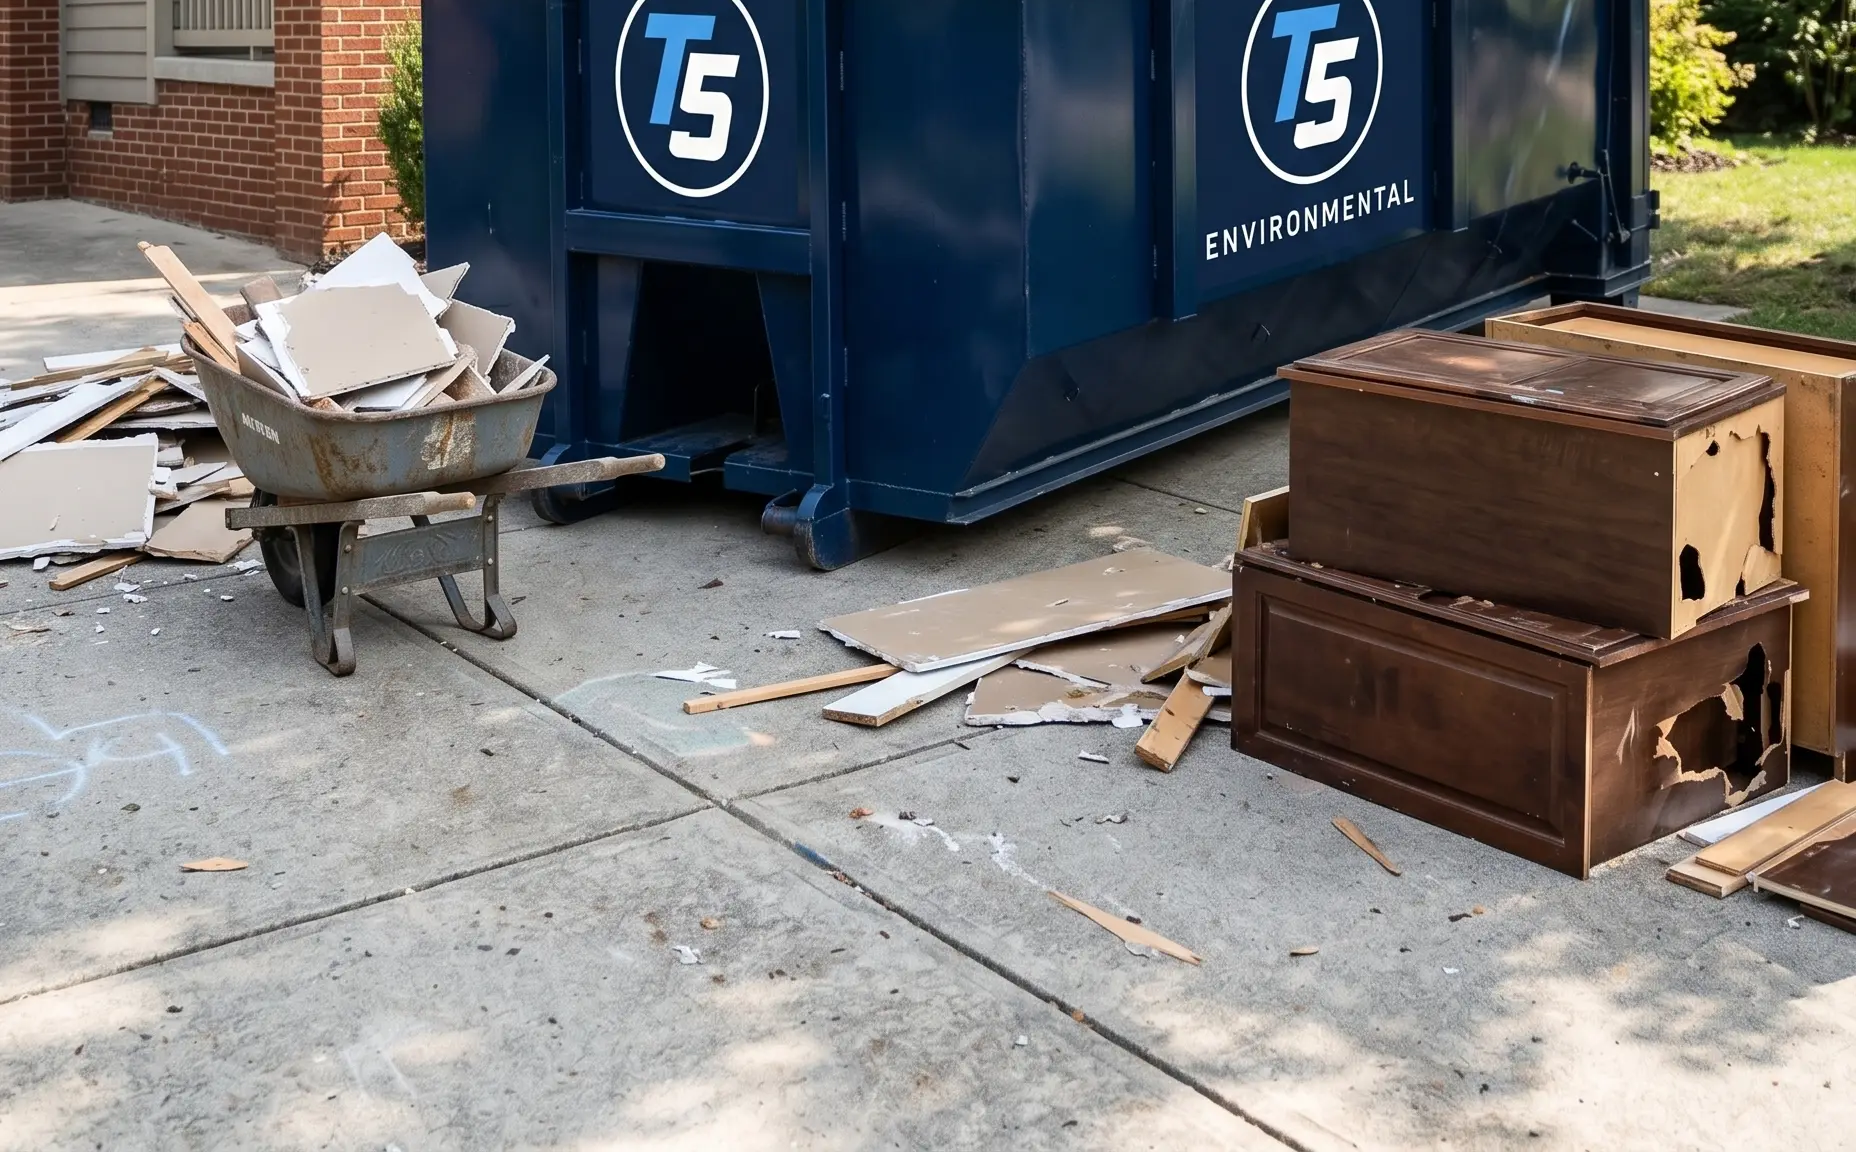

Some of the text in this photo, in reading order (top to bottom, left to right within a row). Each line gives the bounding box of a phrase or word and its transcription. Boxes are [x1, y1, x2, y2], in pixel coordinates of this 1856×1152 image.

[645, 13, 740, 162] T5
[1272, 3, 1359, 149] T5
[1206, 179, 1415, 260] ENVIRONMENTAL
